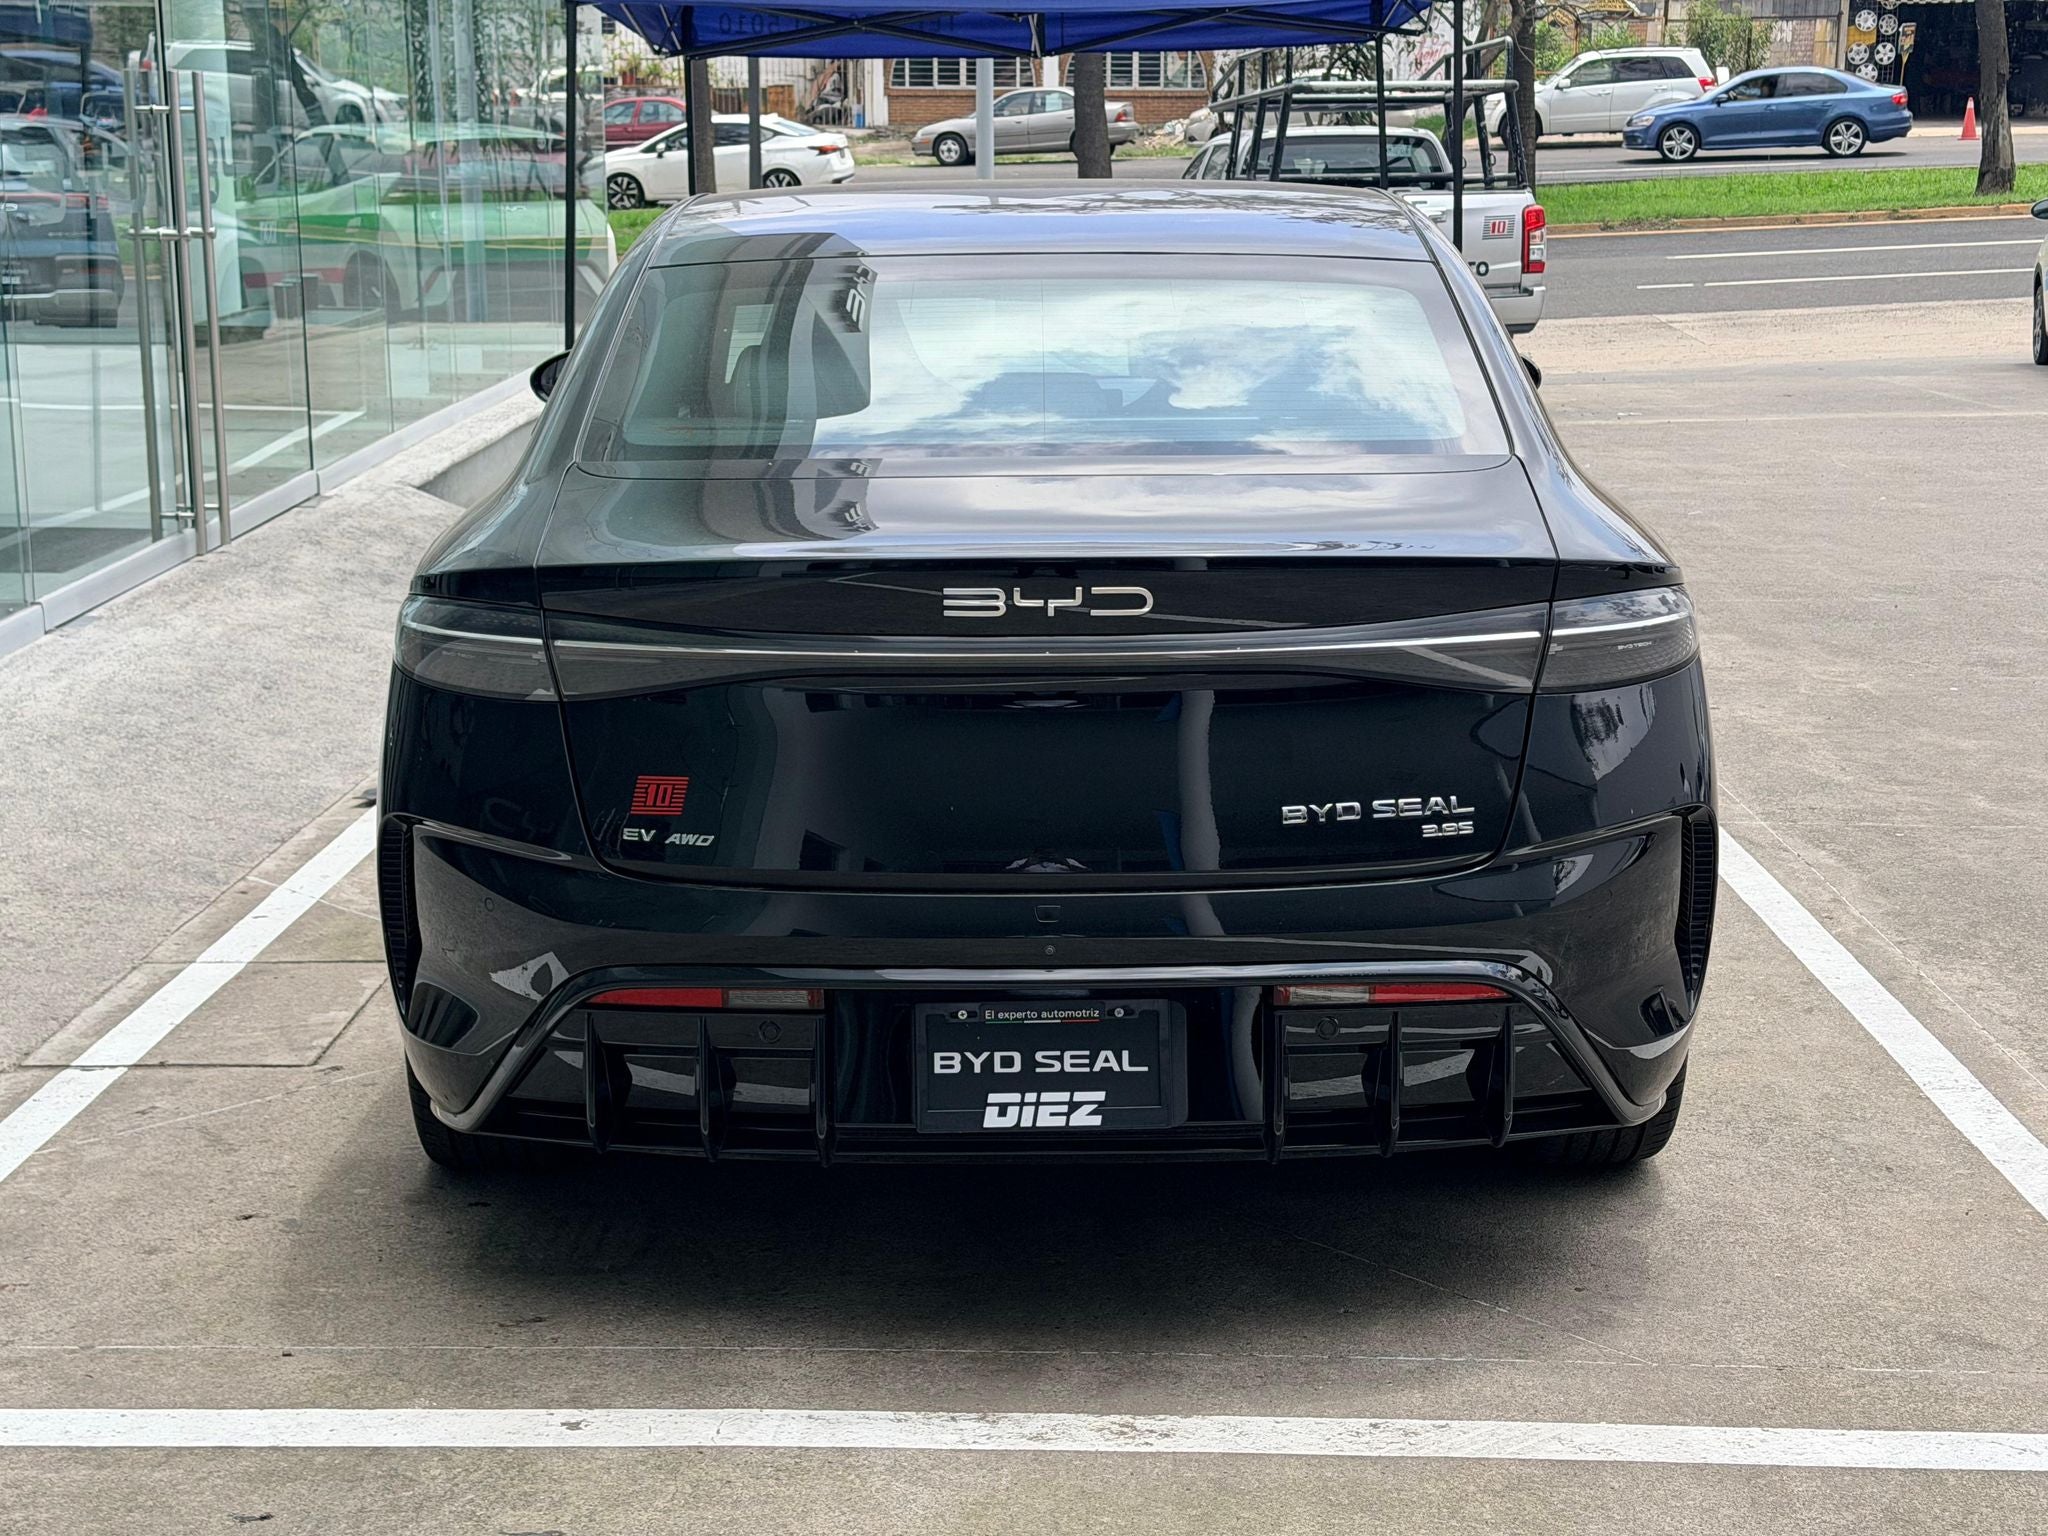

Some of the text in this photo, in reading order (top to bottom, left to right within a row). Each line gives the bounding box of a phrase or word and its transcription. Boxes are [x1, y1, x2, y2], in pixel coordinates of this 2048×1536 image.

[942, 586, 1154, 617] BYD
[1282, 795, 1475, 825] BYD SEAL
[622, 827, 715, 847] EV AWD
[985, 1008, 1100, 1020] El experto automotriz
[933, 1050, 1149, 1074] BYD SEAL
